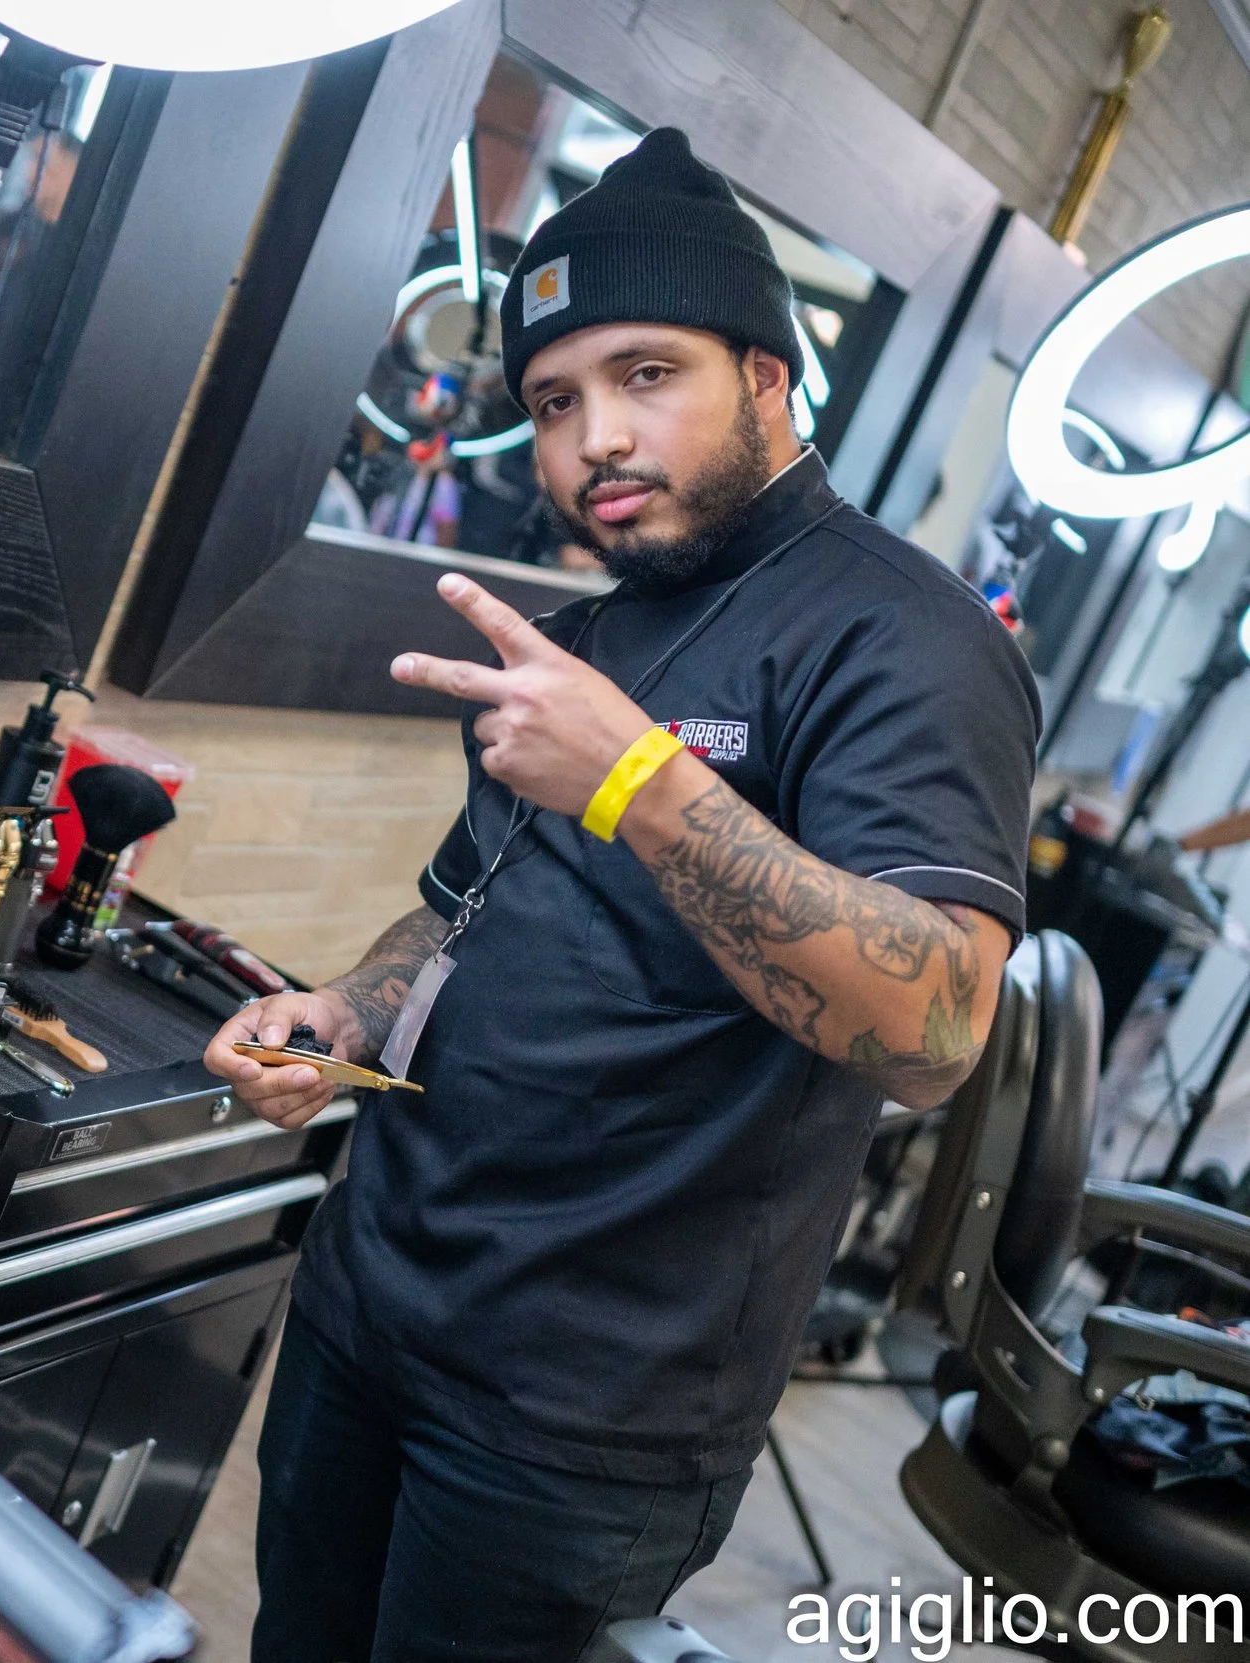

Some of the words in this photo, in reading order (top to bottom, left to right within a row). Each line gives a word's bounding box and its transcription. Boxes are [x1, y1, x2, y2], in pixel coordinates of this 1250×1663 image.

[676, 722, 744, 751] BARBERS
[707, 748, 739, 761] SUPPLIES
[73, 1127, 95, 1141] BALL
[61, 1136, 97, 1152] BEARING
